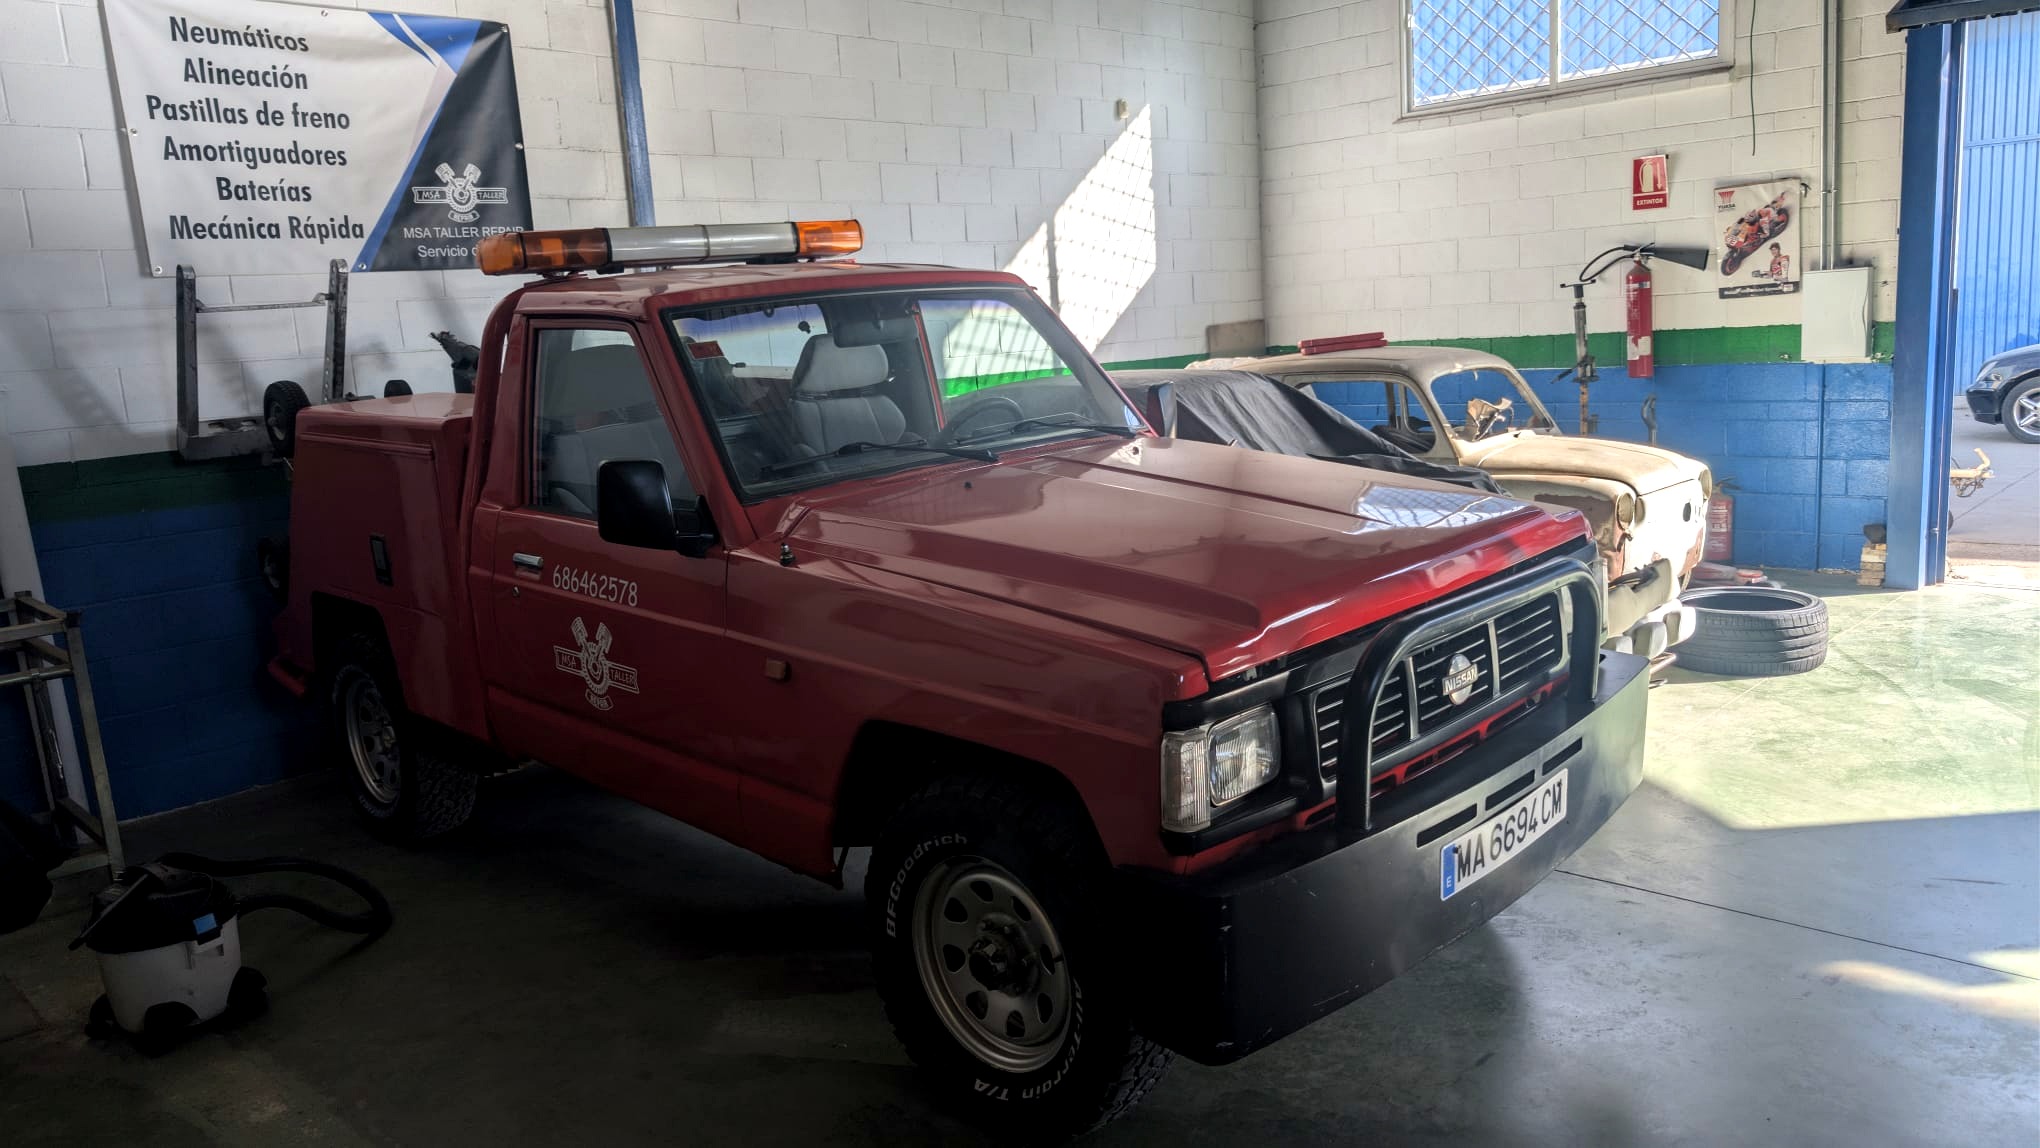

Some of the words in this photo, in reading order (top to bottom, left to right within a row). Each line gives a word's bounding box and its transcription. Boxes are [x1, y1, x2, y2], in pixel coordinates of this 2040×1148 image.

[169, 16, 310, 52] Neumáticos
[183, 58, 309, 90] Alineación
[146, 95, 249, 126] Pastillas
[256, 99, 285, 127] de
[291, 101, 351, 129] freno
[163, 136, 348, 169] Amortiguadores
[215, 177, 313, 202] Baterías
[422, 191, 441, 199] MSA
[1636, 197, 1664, 206] EXTINTOR
[169, 215, 281, 240] Mecánica
[288, 216, 365, 245] Rápida
[403, 227, 432, 239] MSA
[432, 226, 480, 238] TALLER
[417, 245, 468, 258] Servicio
[553, 564, 638, 607] 686462578
[561, 652, 577, 668] MSA
[610, 669, 635, 685] TALLER
[1444, 667, 1476, 693] NISSAN
[1456, 833, 1486, 883] MA
[1489, 797, 1539, 861] 6694
[1541, 780, 1563, 825] CM
[886, 833, 968, 938] BFGoodrich
[1446, 876, 1452, 888] E
